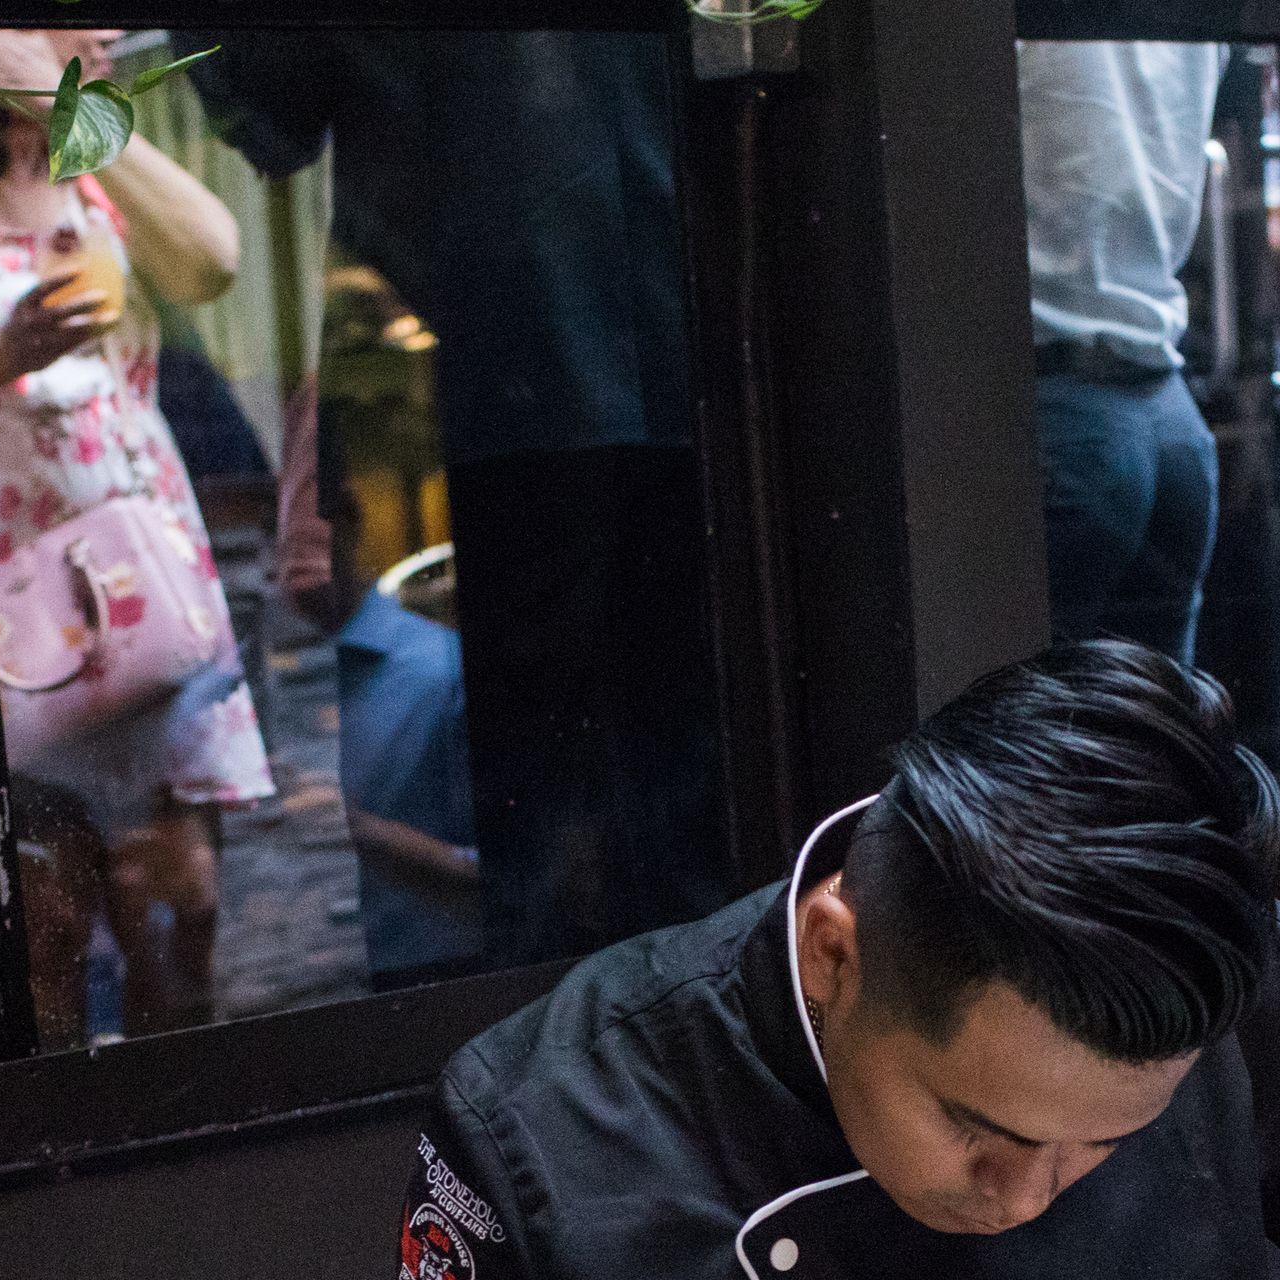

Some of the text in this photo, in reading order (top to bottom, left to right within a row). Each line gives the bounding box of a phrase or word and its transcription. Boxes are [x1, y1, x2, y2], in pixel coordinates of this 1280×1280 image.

[418, 1132, 437, 1165] THE
[438, 1194, 463, 1220] CLOVE
[460, 1211, 488, 1241] LAKES
